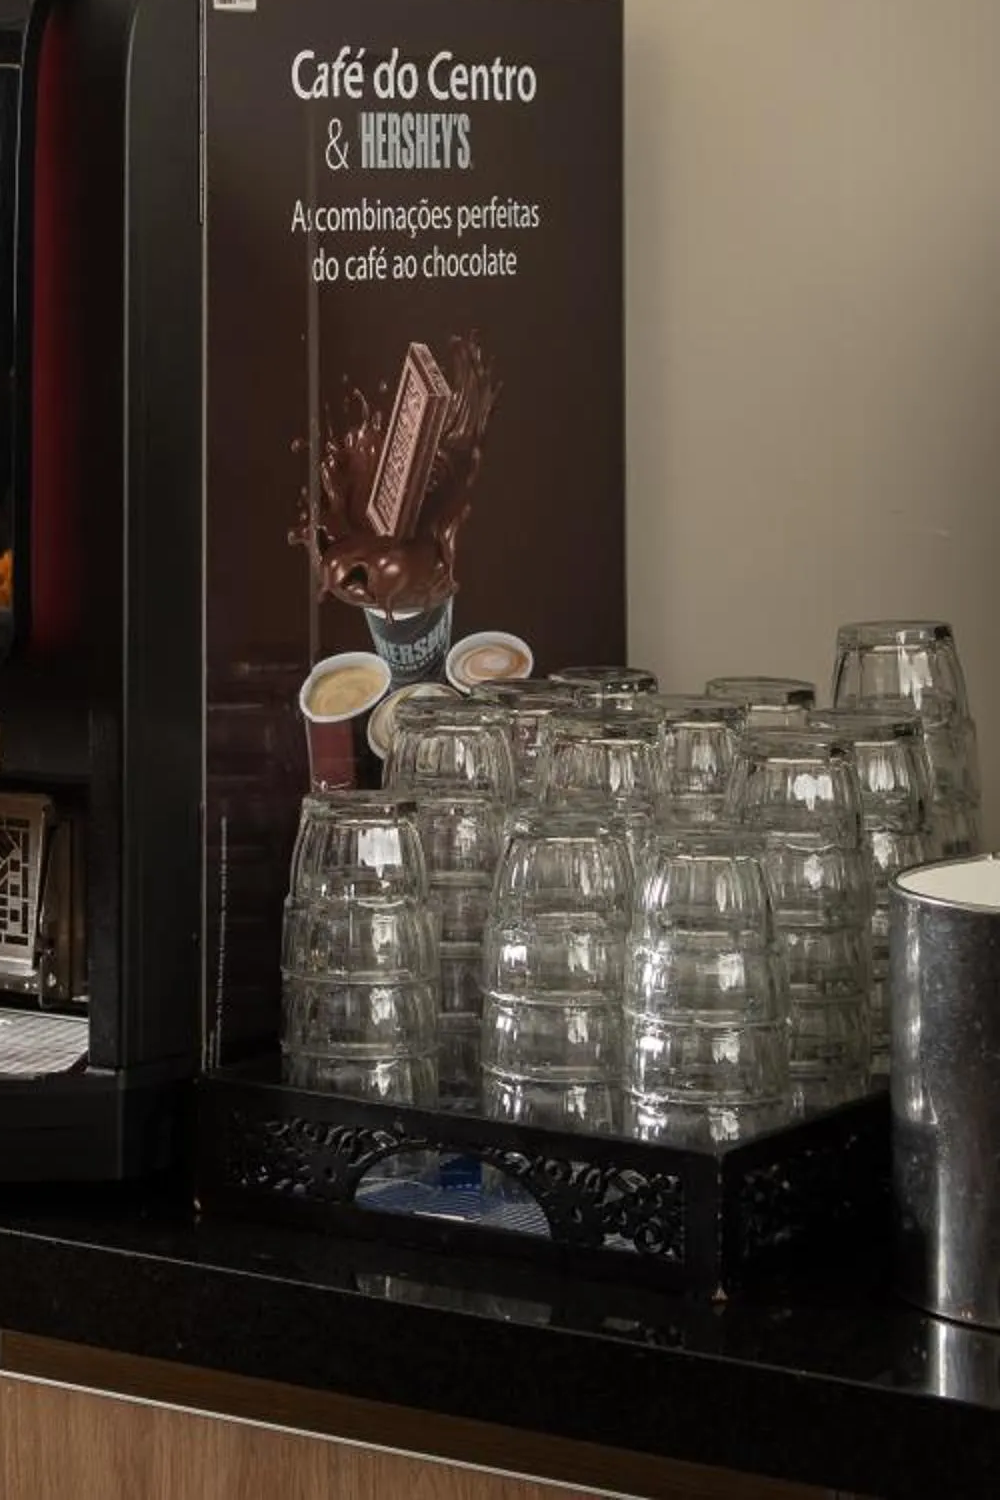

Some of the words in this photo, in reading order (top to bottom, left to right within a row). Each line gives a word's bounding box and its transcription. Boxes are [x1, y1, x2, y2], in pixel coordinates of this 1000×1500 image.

[292, 45, 365, 100] Café
[374, 48, 419, 100] do
[428, 50, 538, 102] Centro
[325, 118, 349, 169] &
[360, 112, 473, 169] HERSHEY'S
[315, 197, 452, 239] combinações
[457, 196, 540, 237] perfeitas
[312, 247, 339, 282] do
[345, 245, 387, 281] café
[393, 255, 418, 280] ao
[423, 245, 517, 279] chocolate
